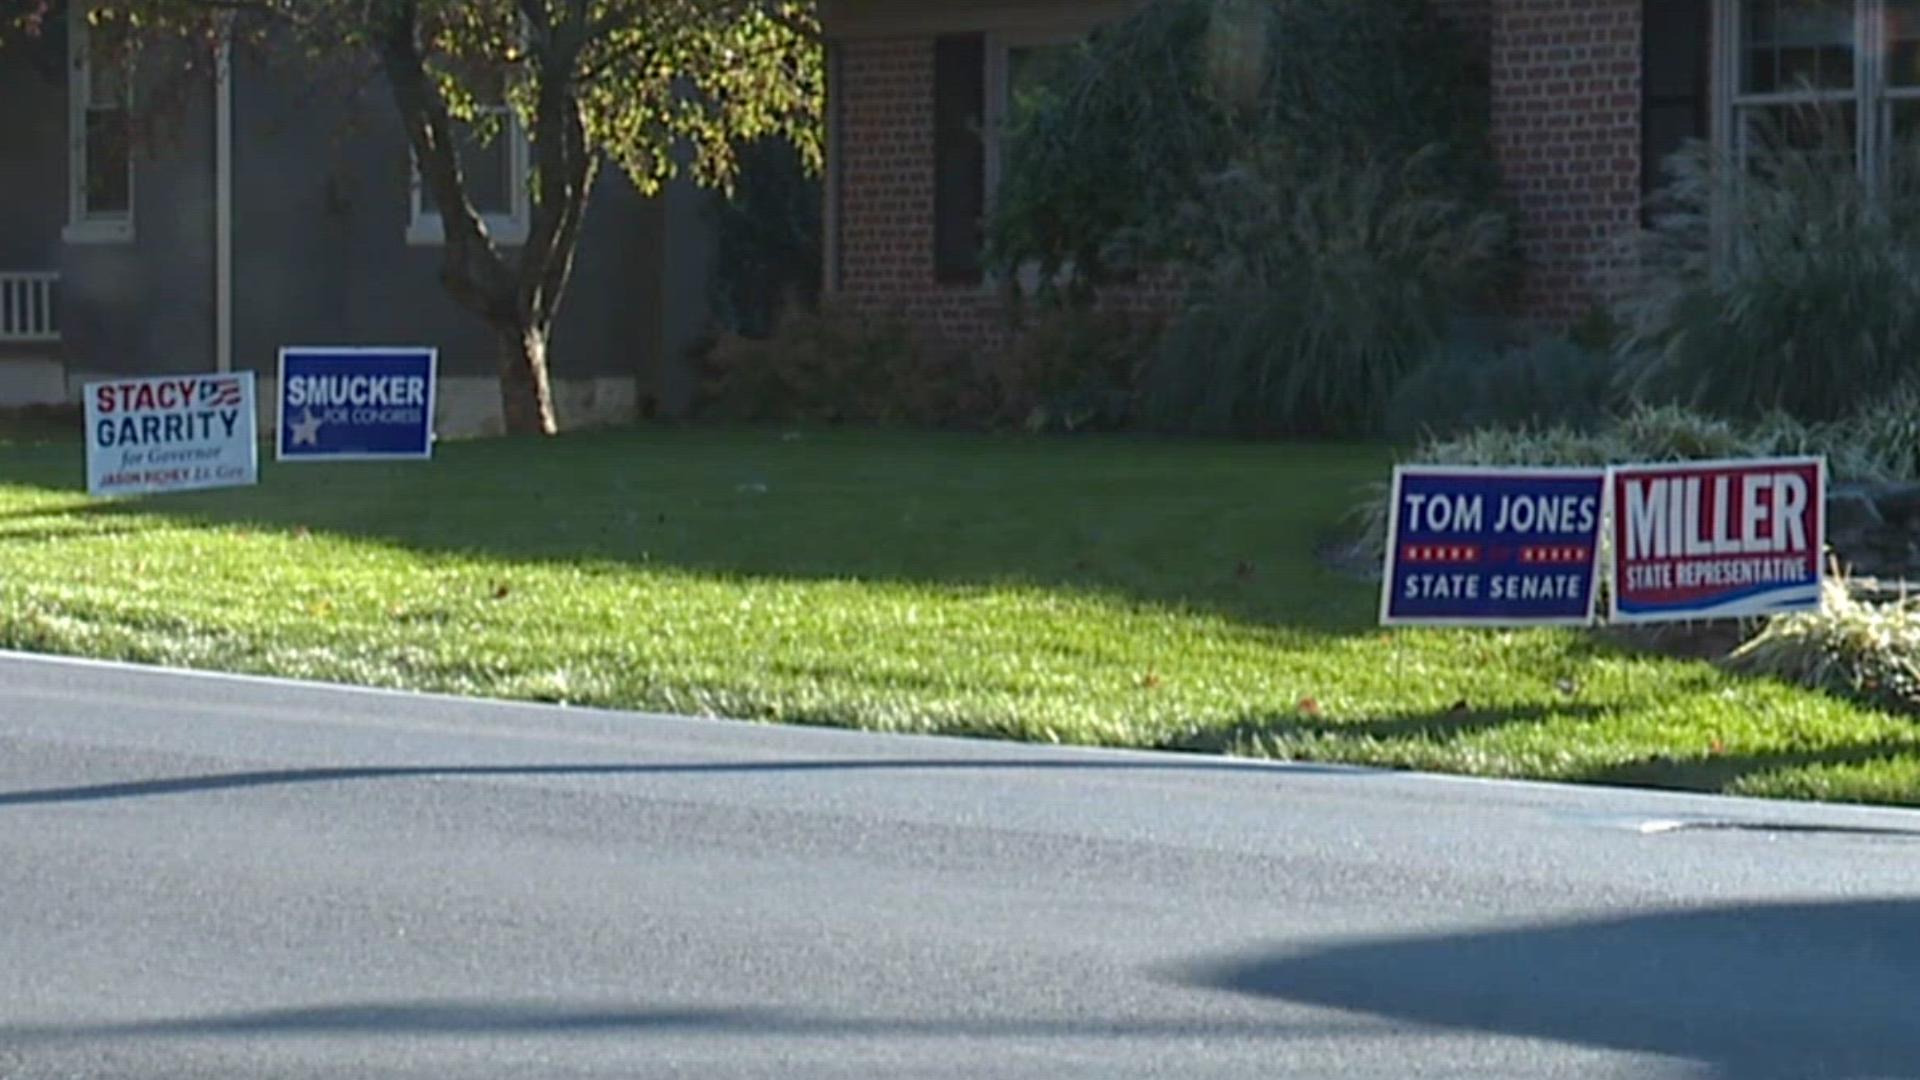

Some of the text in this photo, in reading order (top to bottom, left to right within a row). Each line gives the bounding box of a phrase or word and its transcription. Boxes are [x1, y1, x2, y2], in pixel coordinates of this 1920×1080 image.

[97, 379, 196, 414] STACY
[287, 375, 425, 406] SMUCKER
[97, 410, 238, 448] GARRITY
[121, 446, 221, 469] for Governor
[1405, 494, 1596, 532] TOM JONES
[1624, 473, 1808, 561] MILLER
[1405, 574, 1580, 599] STATE SENATE
[1627, 556, 1808, 591] STATE REPRESENTATIVE
